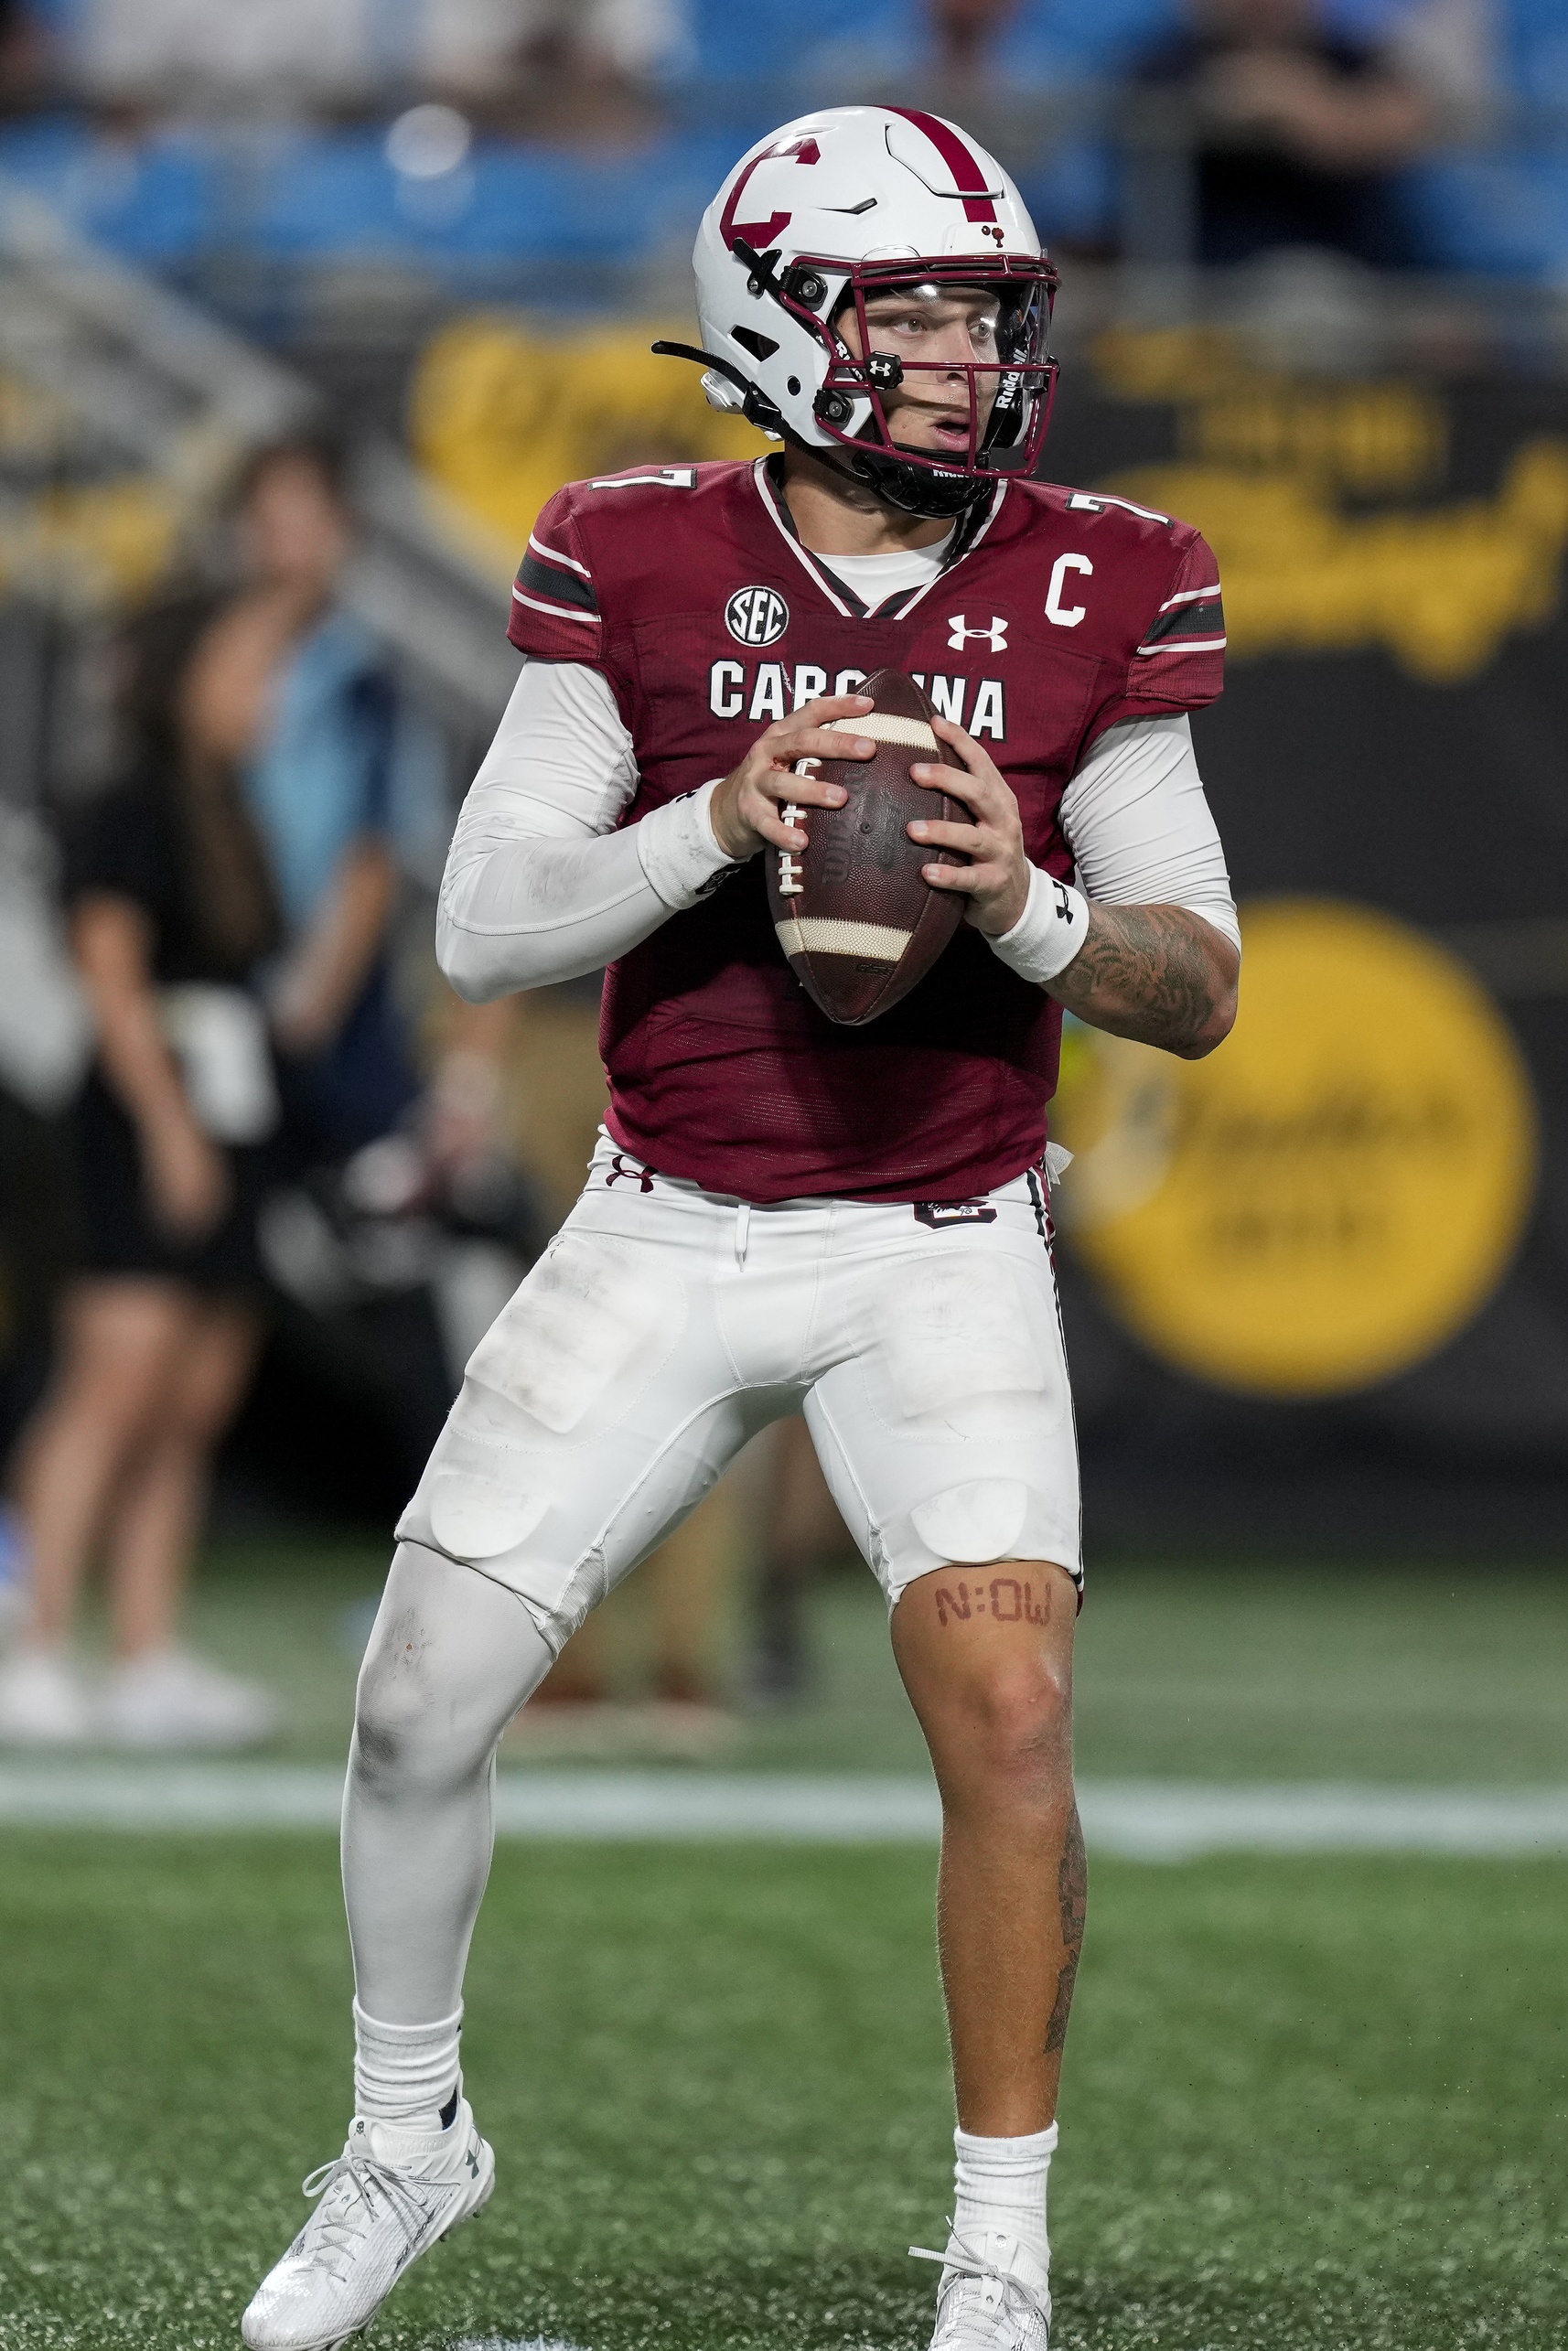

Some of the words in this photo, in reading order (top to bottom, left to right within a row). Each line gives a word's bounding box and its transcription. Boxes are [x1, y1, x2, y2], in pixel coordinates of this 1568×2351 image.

[730, 589, 784, 643] SEC
[1044, 553, 1094, 628] C
[707, 659, 1006, 741] CARNA
